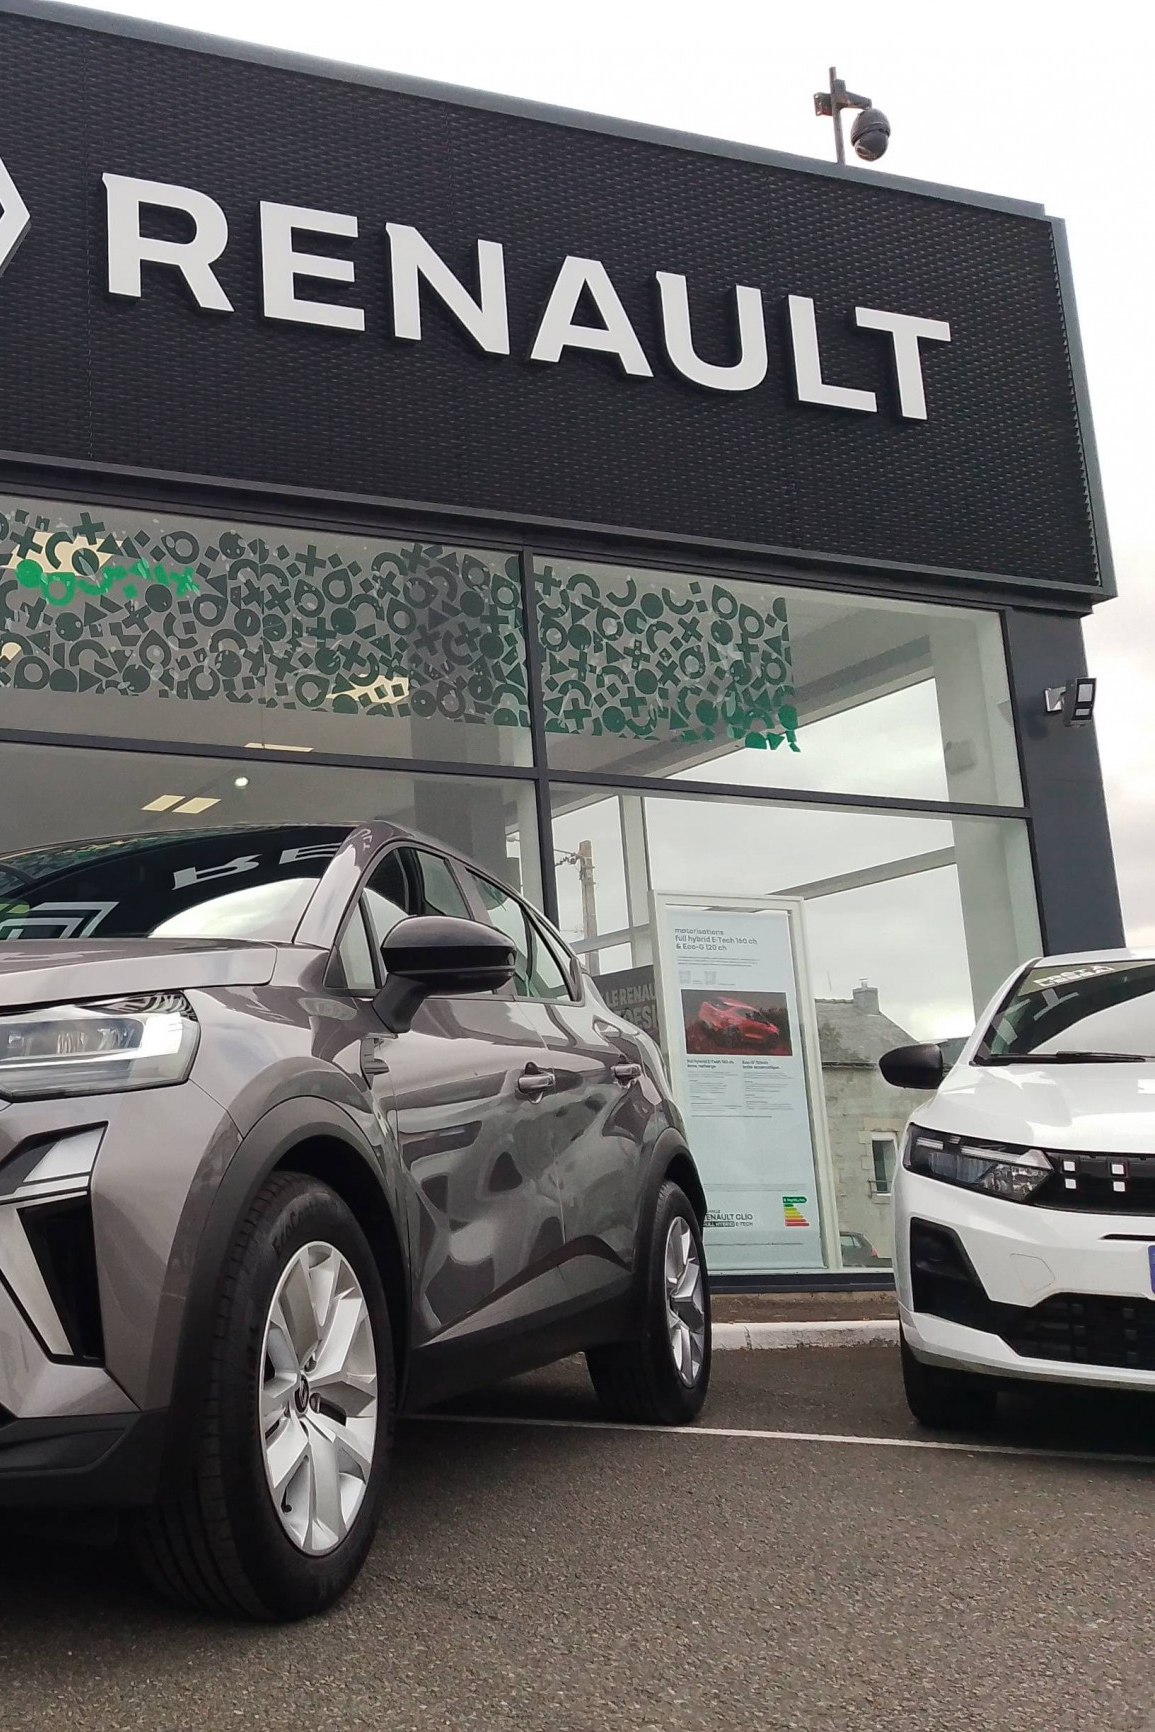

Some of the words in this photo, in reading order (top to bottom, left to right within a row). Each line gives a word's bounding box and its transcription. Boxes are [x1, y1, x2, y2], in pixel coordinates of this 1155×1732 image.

[101, 172, 951, 421] RENAULT
[674, 928, 724, 936] motorisations
[675, 935, 686, 943] full
[688, 935, 711, 944] hybrid
[712, 937, 735, 945] E-Tech
[748, 938, 758, 946] ch
[704, 1213, 735, 1221] ENAULT
[735, 1213, 753, 1221] CLIO
